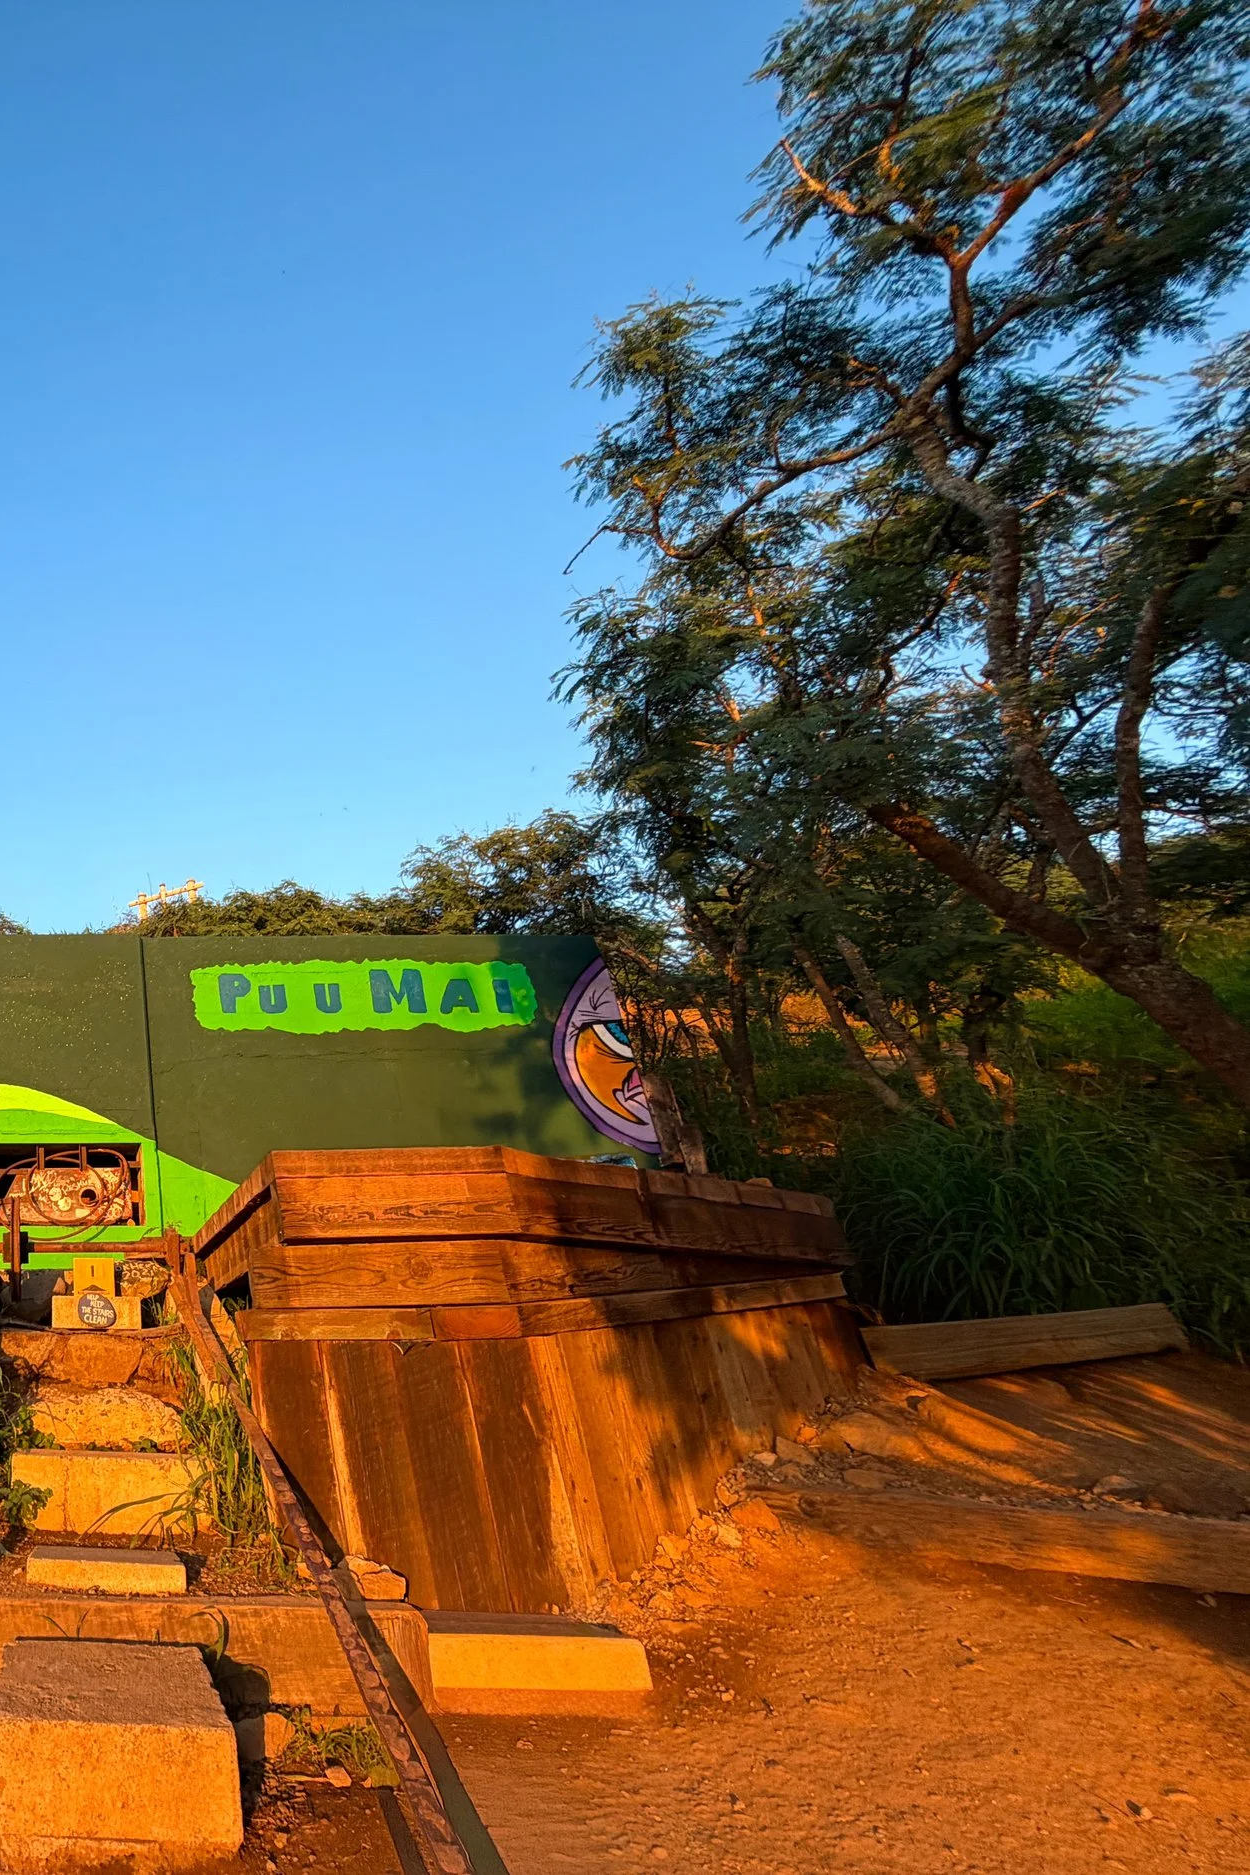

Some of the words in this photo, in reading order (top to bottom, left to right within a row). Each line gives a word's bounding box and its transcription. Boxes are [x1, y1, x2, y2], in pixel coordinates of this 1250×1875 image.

[86, 1293, 100, 1301] HELP
[90, 1300, 105, 1308] KEEP
[81, 1305, 92, 1314] THE
[92, 1308, 114, 1319] STAIRS
[83, 1313, 108, 1325] CLEAN
